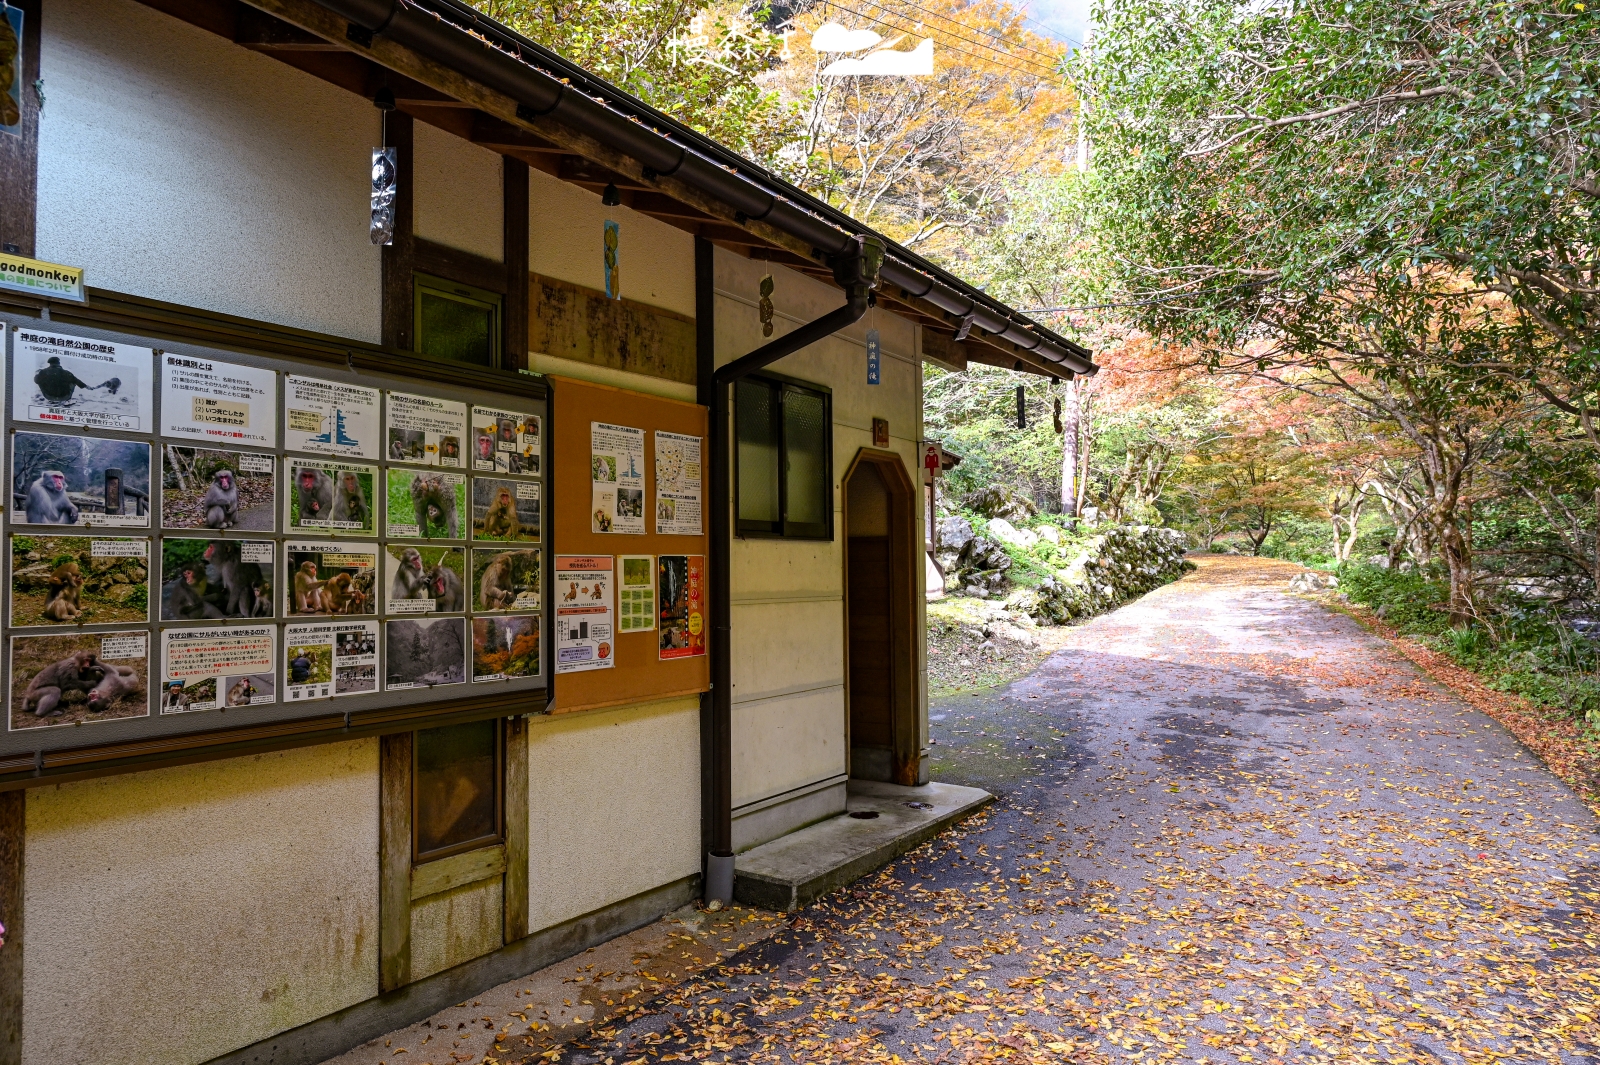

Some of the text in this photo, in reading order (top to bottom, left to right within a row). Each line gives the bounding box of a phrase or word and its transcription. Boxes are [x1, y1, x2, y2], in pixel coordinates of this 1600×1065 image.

[20, 332, 116, 355] 神庭の滝自然公園の歴史
[167, 356, 213, 371] 個体識別とは
[868, 341, 878, 381] 神庭の滝
[205, 407, 245, 418] いつ死亡したか
[205, 415, 245, 426] いつ生まれたか
